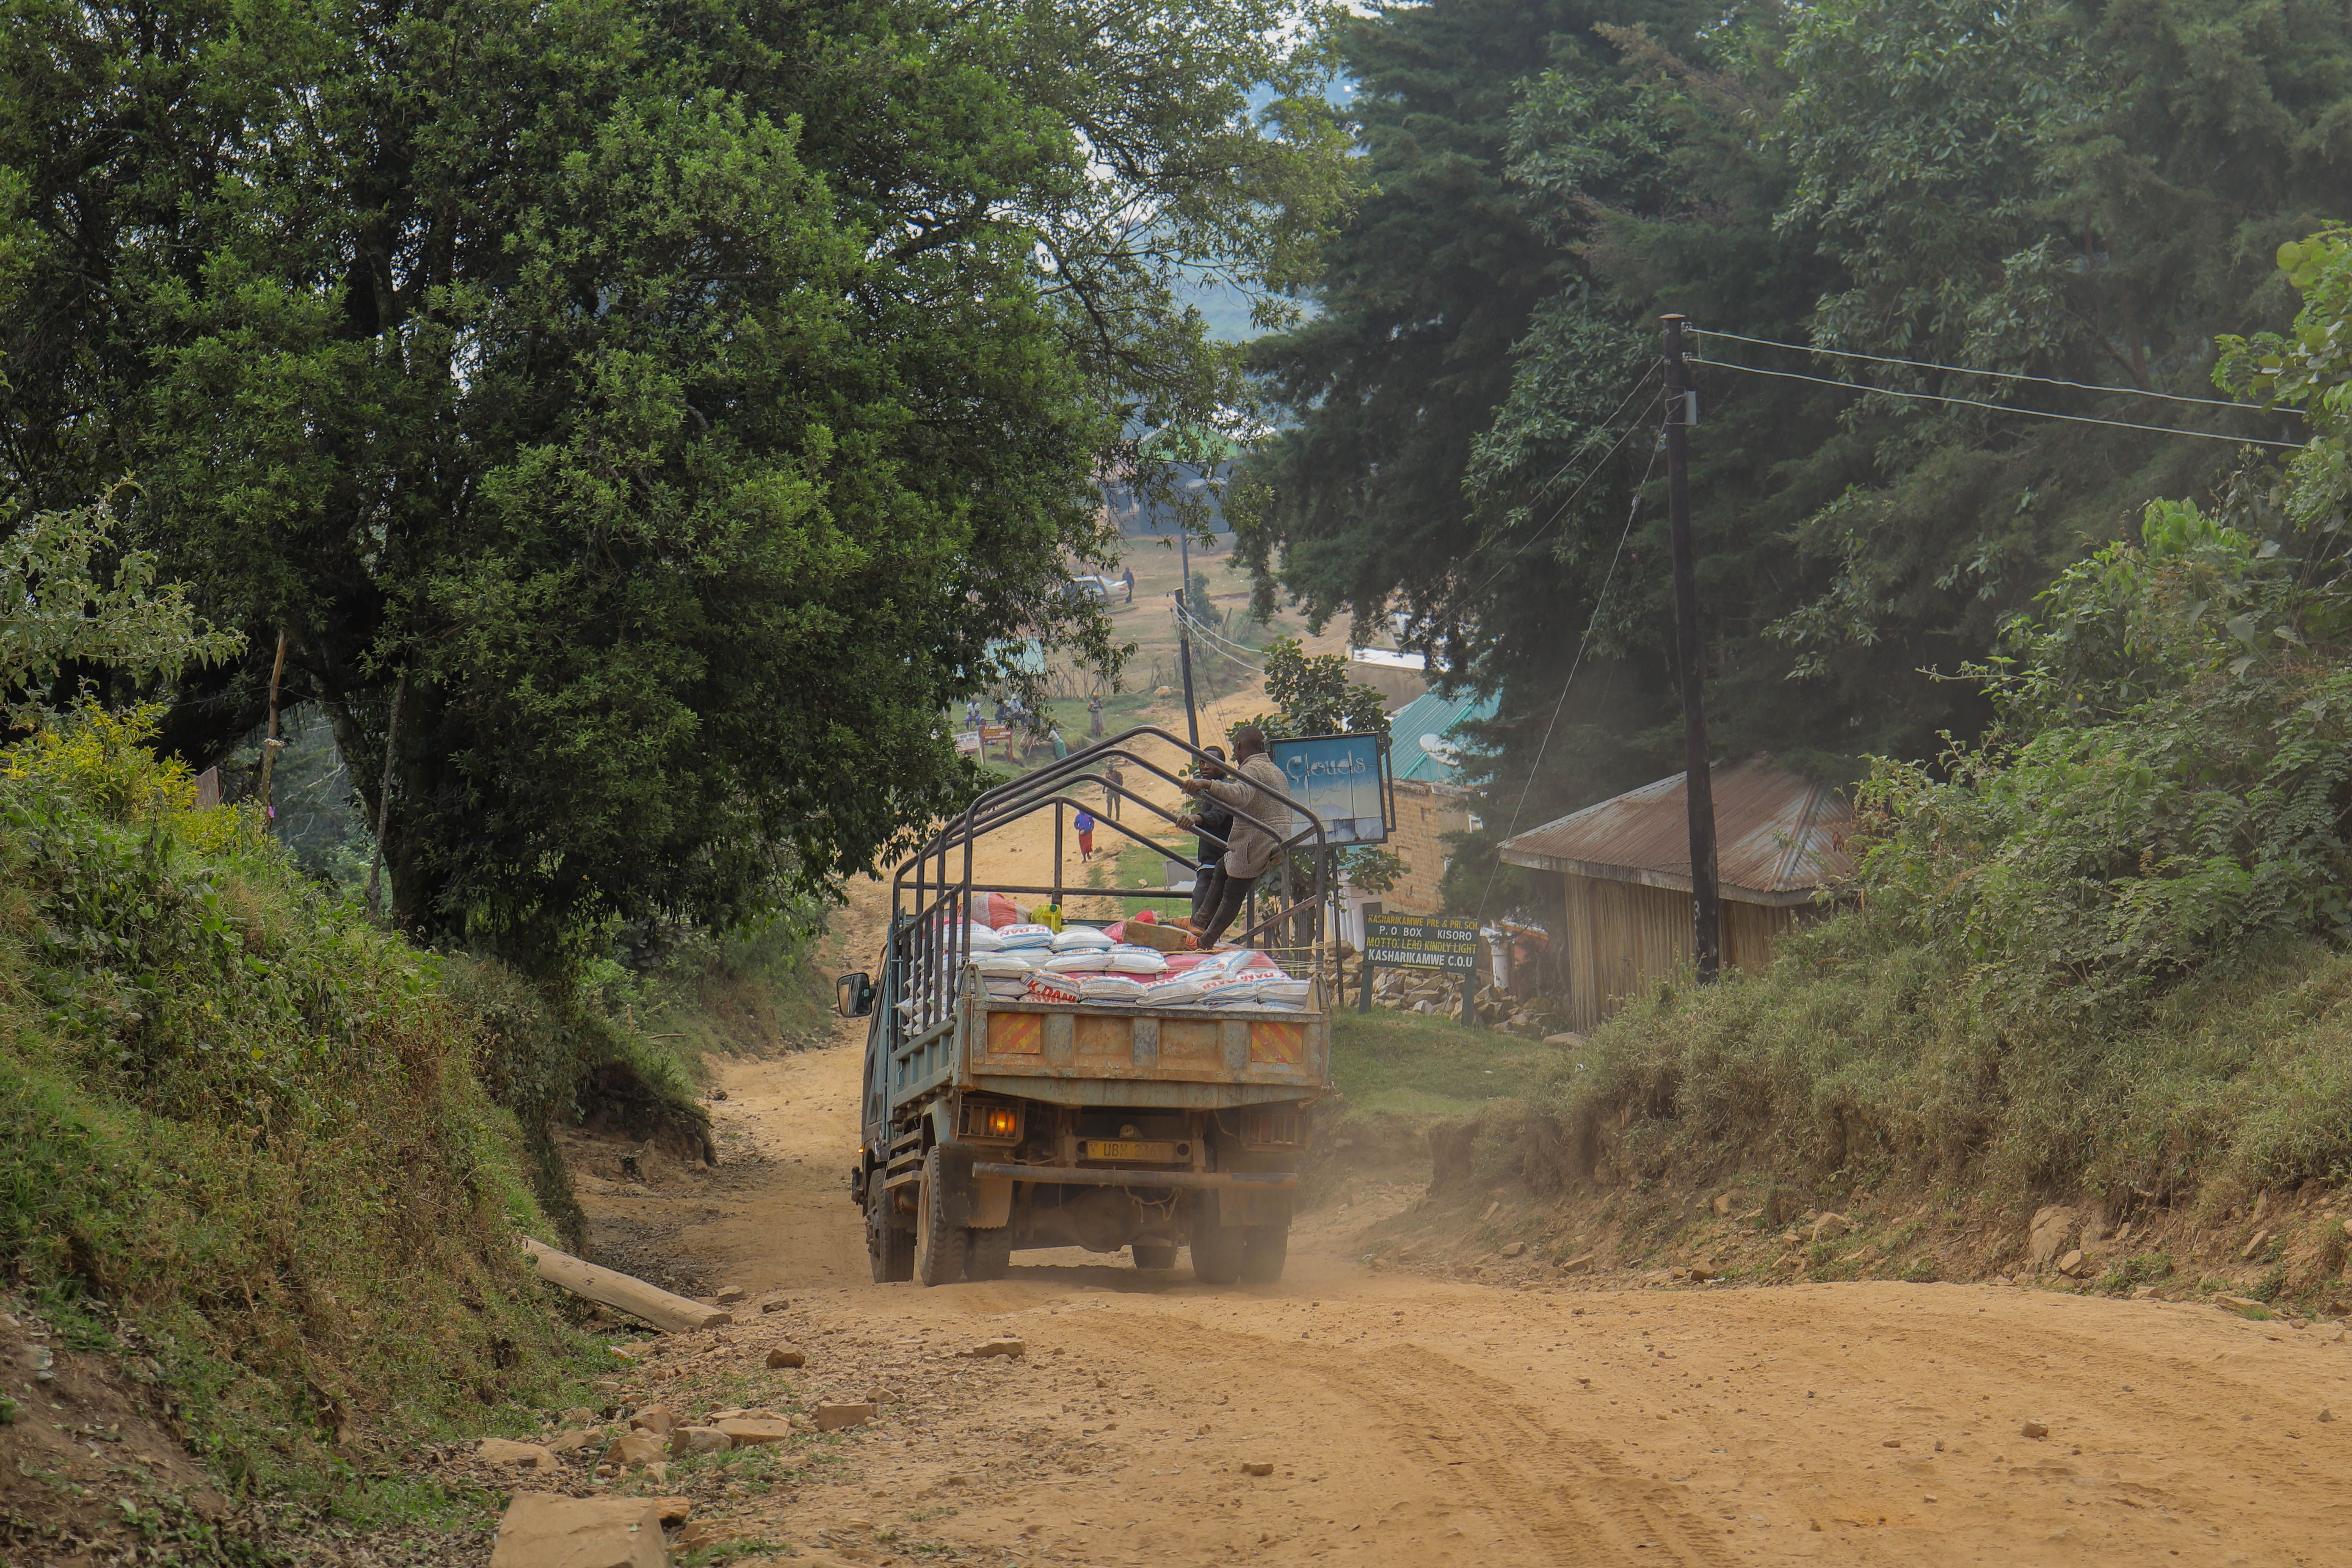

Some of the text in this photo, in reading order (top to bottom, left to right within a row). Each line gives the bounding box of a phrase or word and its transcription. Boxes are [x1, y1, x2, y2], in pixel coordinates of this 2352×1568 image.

[1287, 750, 1365, 784] Clouds
[1368, 914, 1479, 931] KASHARIKAMWE PRE & PRI. SCH.
[1403, 927, 1423, 937] BOX
[1437, 929, 1472, 941] KISORO
[1367, 937, 1477, 955] MOTTO: LEAD KINDLY LIGHT
[1368, 949, 1473, 968] KASHARIKAMWE C.O.U
